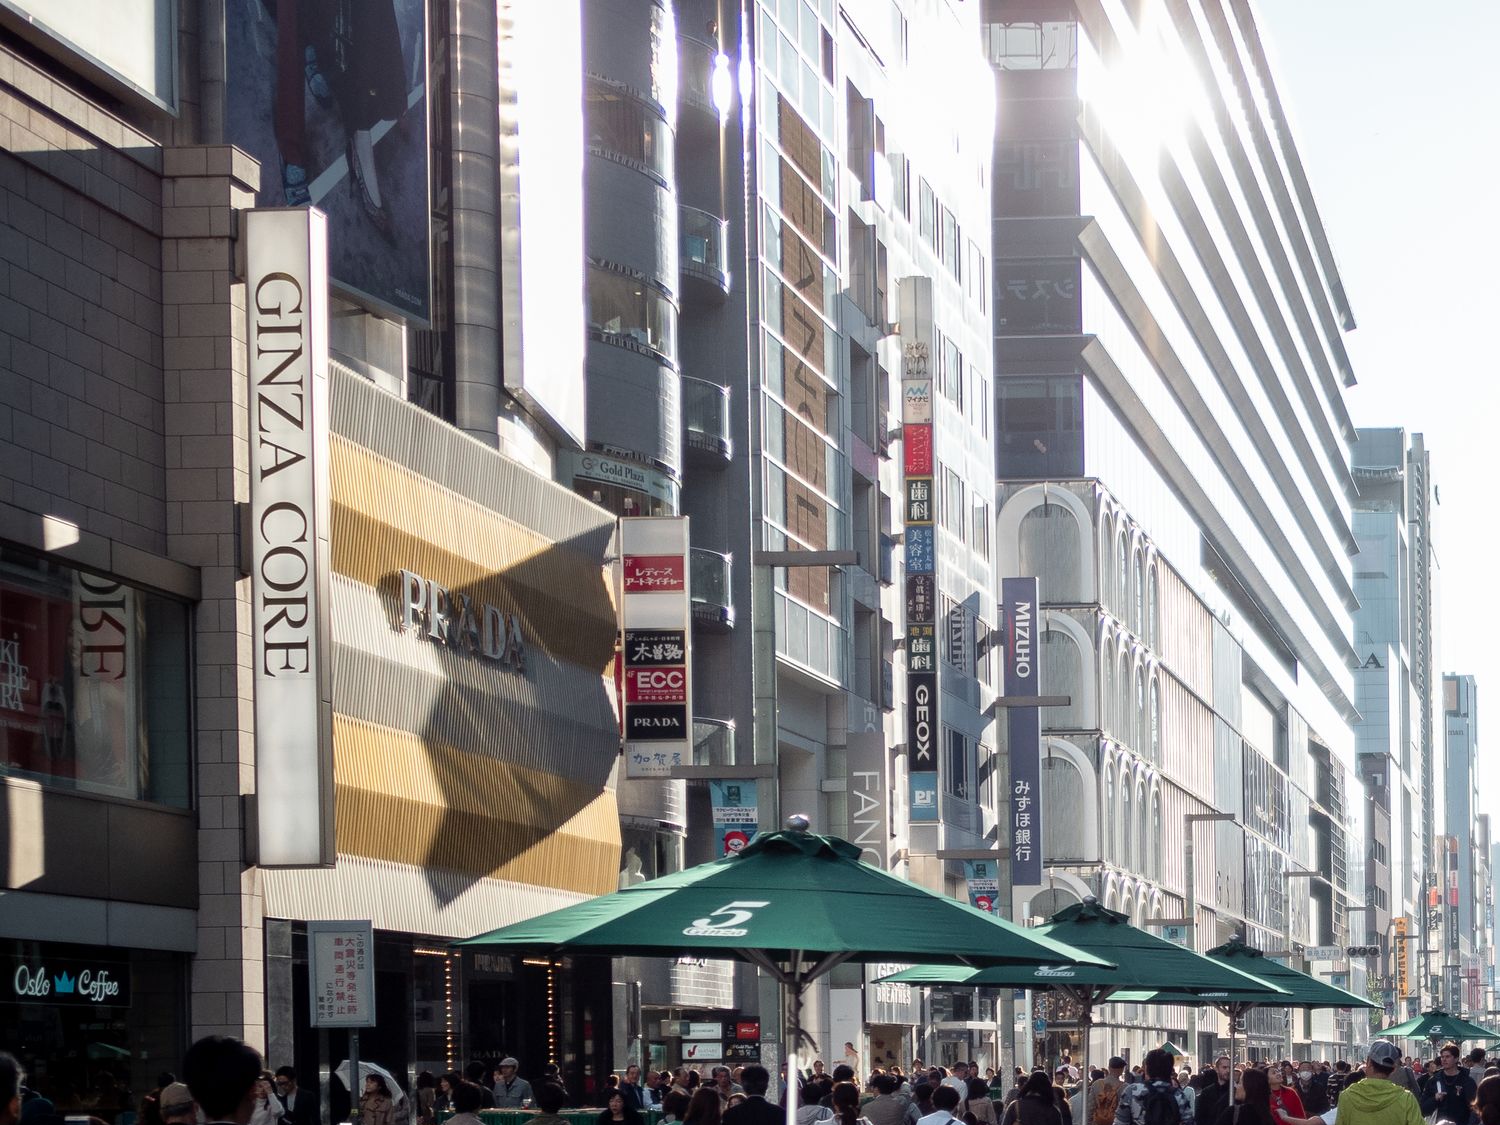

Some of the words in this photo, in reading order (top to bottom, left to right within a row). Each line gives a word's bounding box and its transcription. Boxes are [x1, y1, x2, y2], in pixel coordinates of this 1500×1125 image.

[256, 271, 305, 480] GINZA
[906, 395, 929, 403] マイナビ
[600, 461, 622, 477] Gold
[625, 467, 645, 483] Plaza
[911, 481, 929, 521] 歯科
[909, 529, 923, 571] 美容室
[625, 577, 684, 586] アートネイチャー
[635, 567, 673, 577] レディース
[260, 501, 310, 678] CORE
[399, 568, 526, 671] PRADA
[911, 637, 933, 670] 歯科
[1015, 601, 1031, 679] MIZUHO
[637, 671, 684, 689] ECC
[633, 717, 680, 727] PRADA
[915, 684, 931, 762] GEOX
[633, 752, 682, 767] 加賀屋
[1014, 780, 1032, 862] みずほ銀行
[692, 900, 771, 928] 5
[15, 964, 51, 997] Oslo
[78, 968, 119, 1002] Coffee
[876, 986, 912, 1005] BREATHES
[1429, 1025, 1442, 1034] 5
